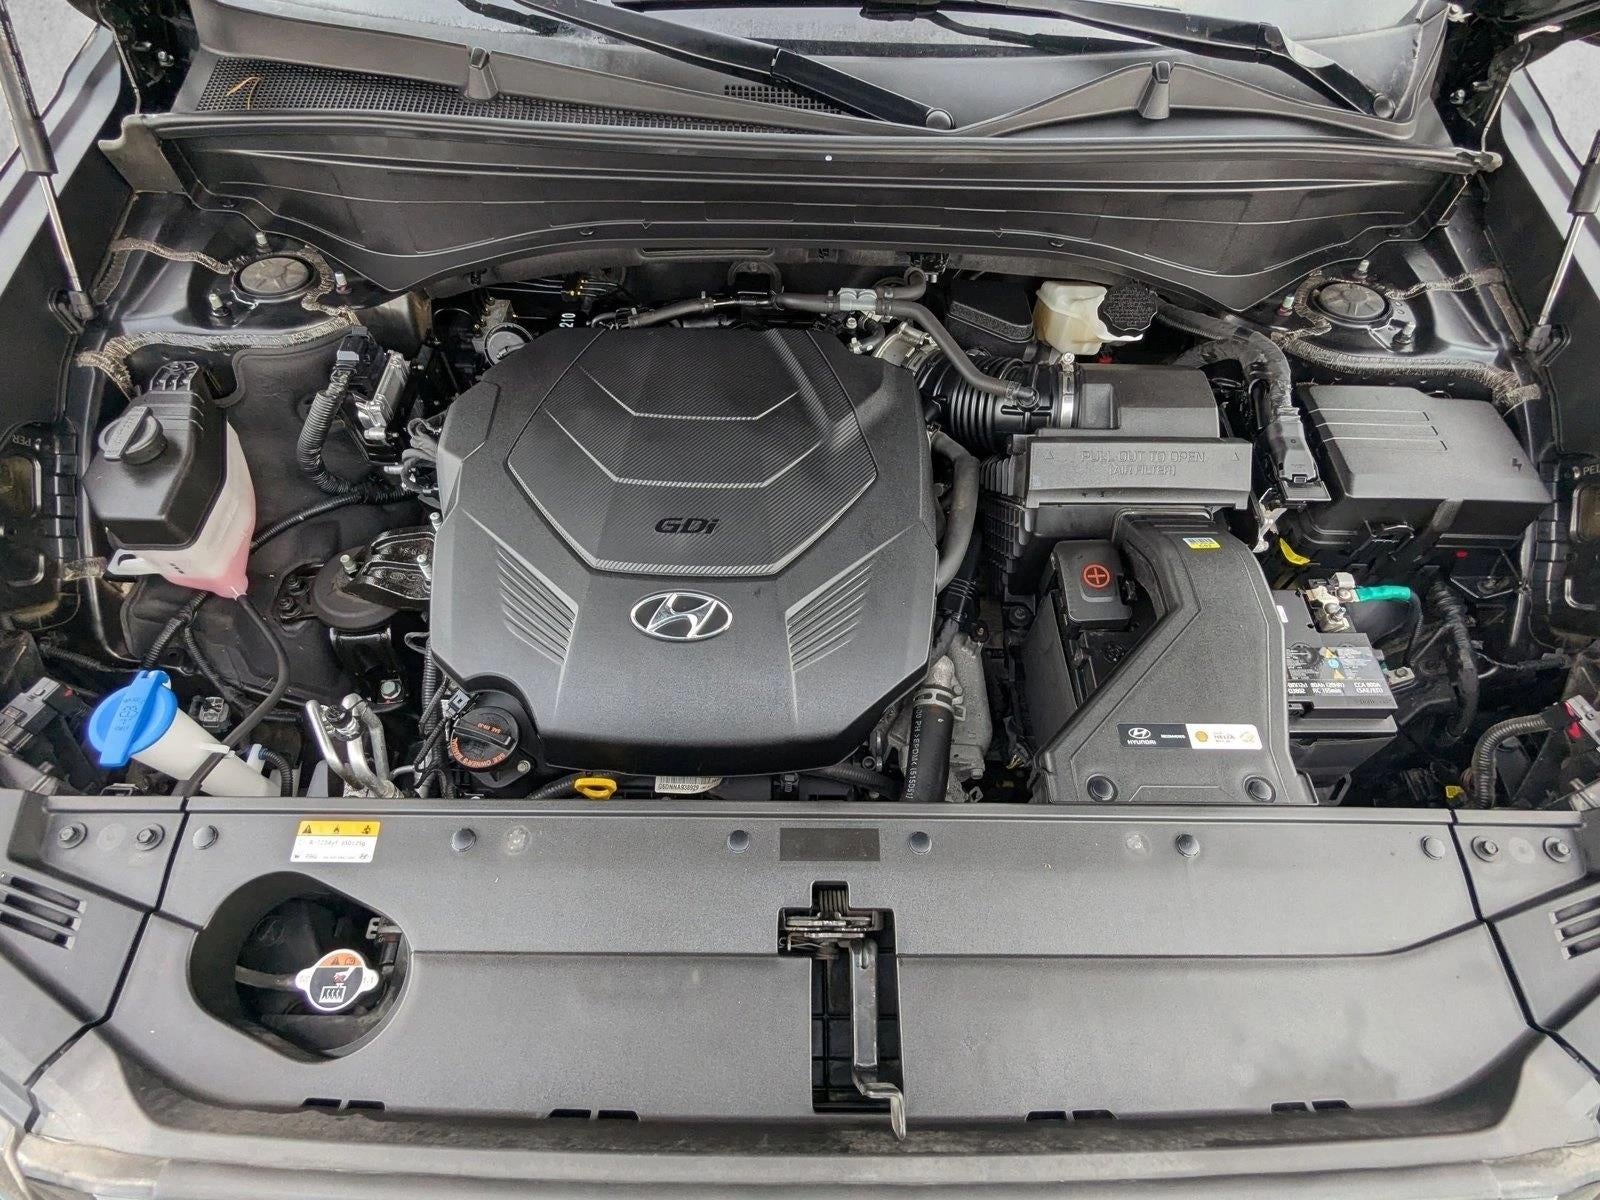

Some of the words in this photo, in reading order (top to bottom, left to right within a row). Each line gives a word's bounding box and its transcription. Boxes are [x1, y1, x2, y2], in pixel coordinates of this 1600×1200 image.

[559, 312, 576, 328] 210
[1081, 450, 1111, 463] PULL
[1118, 450, 1146, 463] OUT
[1149, 450, 1167, 463] TO
[1170, 450, 1207, 463] OPEN
[655, 517, 720, 535] GDi
